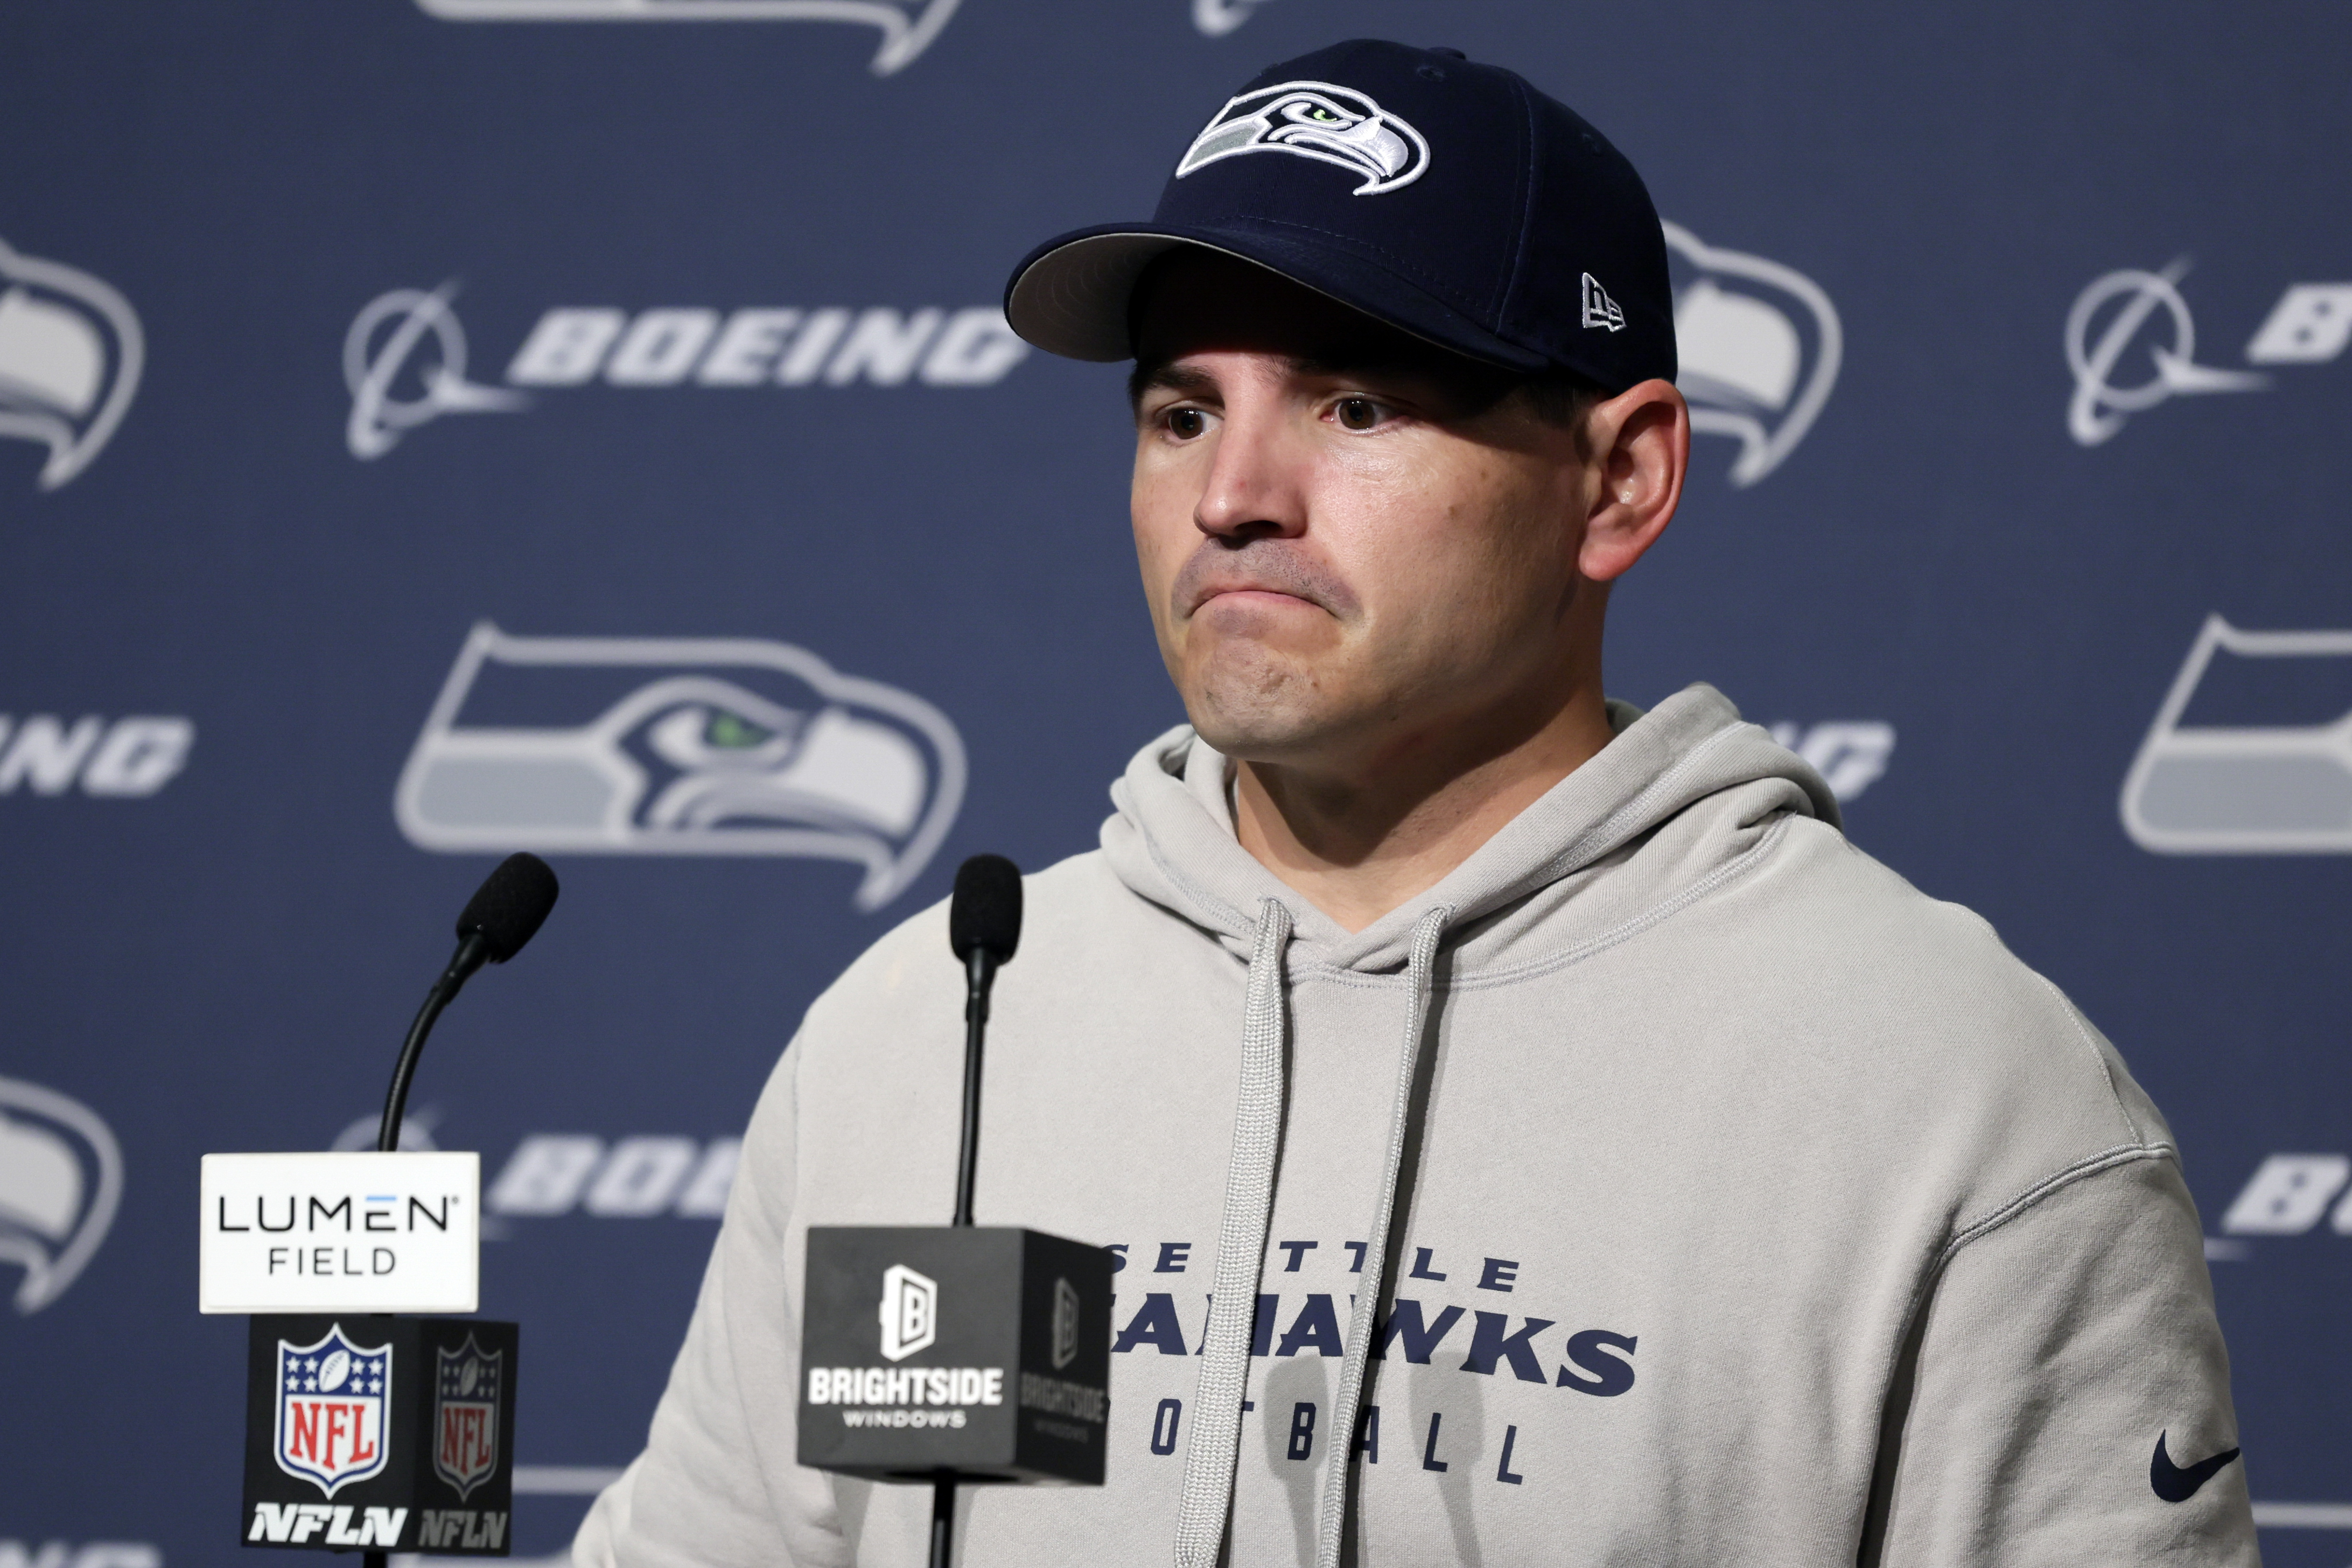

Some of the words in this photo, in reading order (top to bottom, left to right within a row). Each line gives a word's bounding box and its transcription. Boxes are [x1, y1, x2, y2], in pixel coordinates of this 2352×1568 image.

[507, 307, 1027, 386] BOEING
[0, 714, 197, 796] NG
[269, 1247, 396, 1276] FIELD
[1102, 1241, 1520, 1292] SETTLE
[808, 1368, 1004, 1406] BRIGHTSIDE
[290, 1401, 374, 1471] NFL
[441, 1407, 491, 1475] NFL
[842, 1409, 967, 1429] WINDOWS
[248, 1502, 409, 1547] NFLN
[418, 1509, 508, 1549] NFLN
